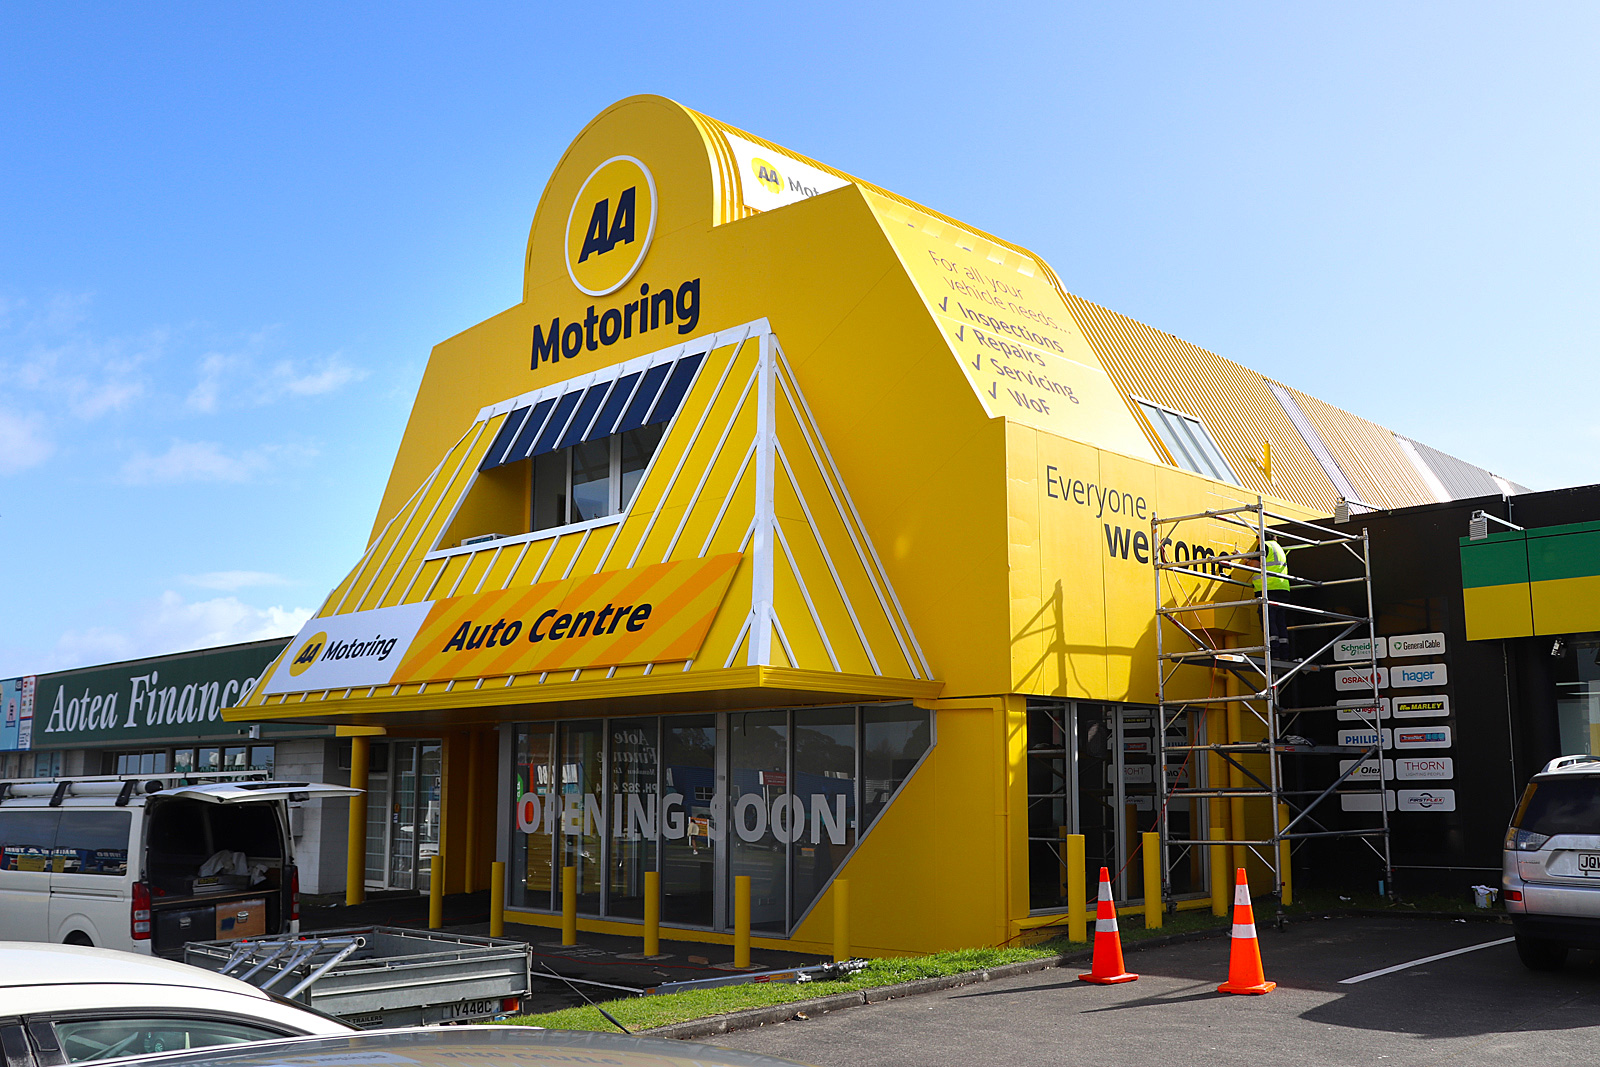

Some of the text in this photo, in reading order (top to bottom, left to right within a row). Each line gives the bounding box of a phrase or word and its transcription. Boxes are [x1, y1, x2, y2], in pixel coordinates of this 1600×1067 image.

[759, 166, 780, 185] AA
[577, 186, 636, 264] AA
[928, 250, 1023, 300] For all your
[943, 276, 1006, 310] vehicle
[530, 278, 700, 370] Motoring
[957, 302, 1064, 353] Inspections
[973, 329, 1046, 366] Repairs
[990, 358, 1079, 404] Servicing
[1007, 388, 1050, 415] WoF
[1046, 465, 1147, 519] Everyone
[1104, 523, 1231, 579] wecome
[442, 602, 653, 654] Auto Centre
[1403, 639, 1440, 650] General Cable
[293, 634, 398, 664] AA Motoring
[1341, 642, 1379, 652] Schneidr
[1342, 676, 1368, 684] OSRAM
[1402, 670, 1435, 683] hager
[44, 684, 118, 733] Aotea
[1411, 702, 1442, 710] MARLEY
[1404, 761, 1445, 770] THORN
[517, 792, 684, 840] OPENING
[1580, 856, 1600, 869] JQ
[352, 1014, 383, 1023] TRAILERS
